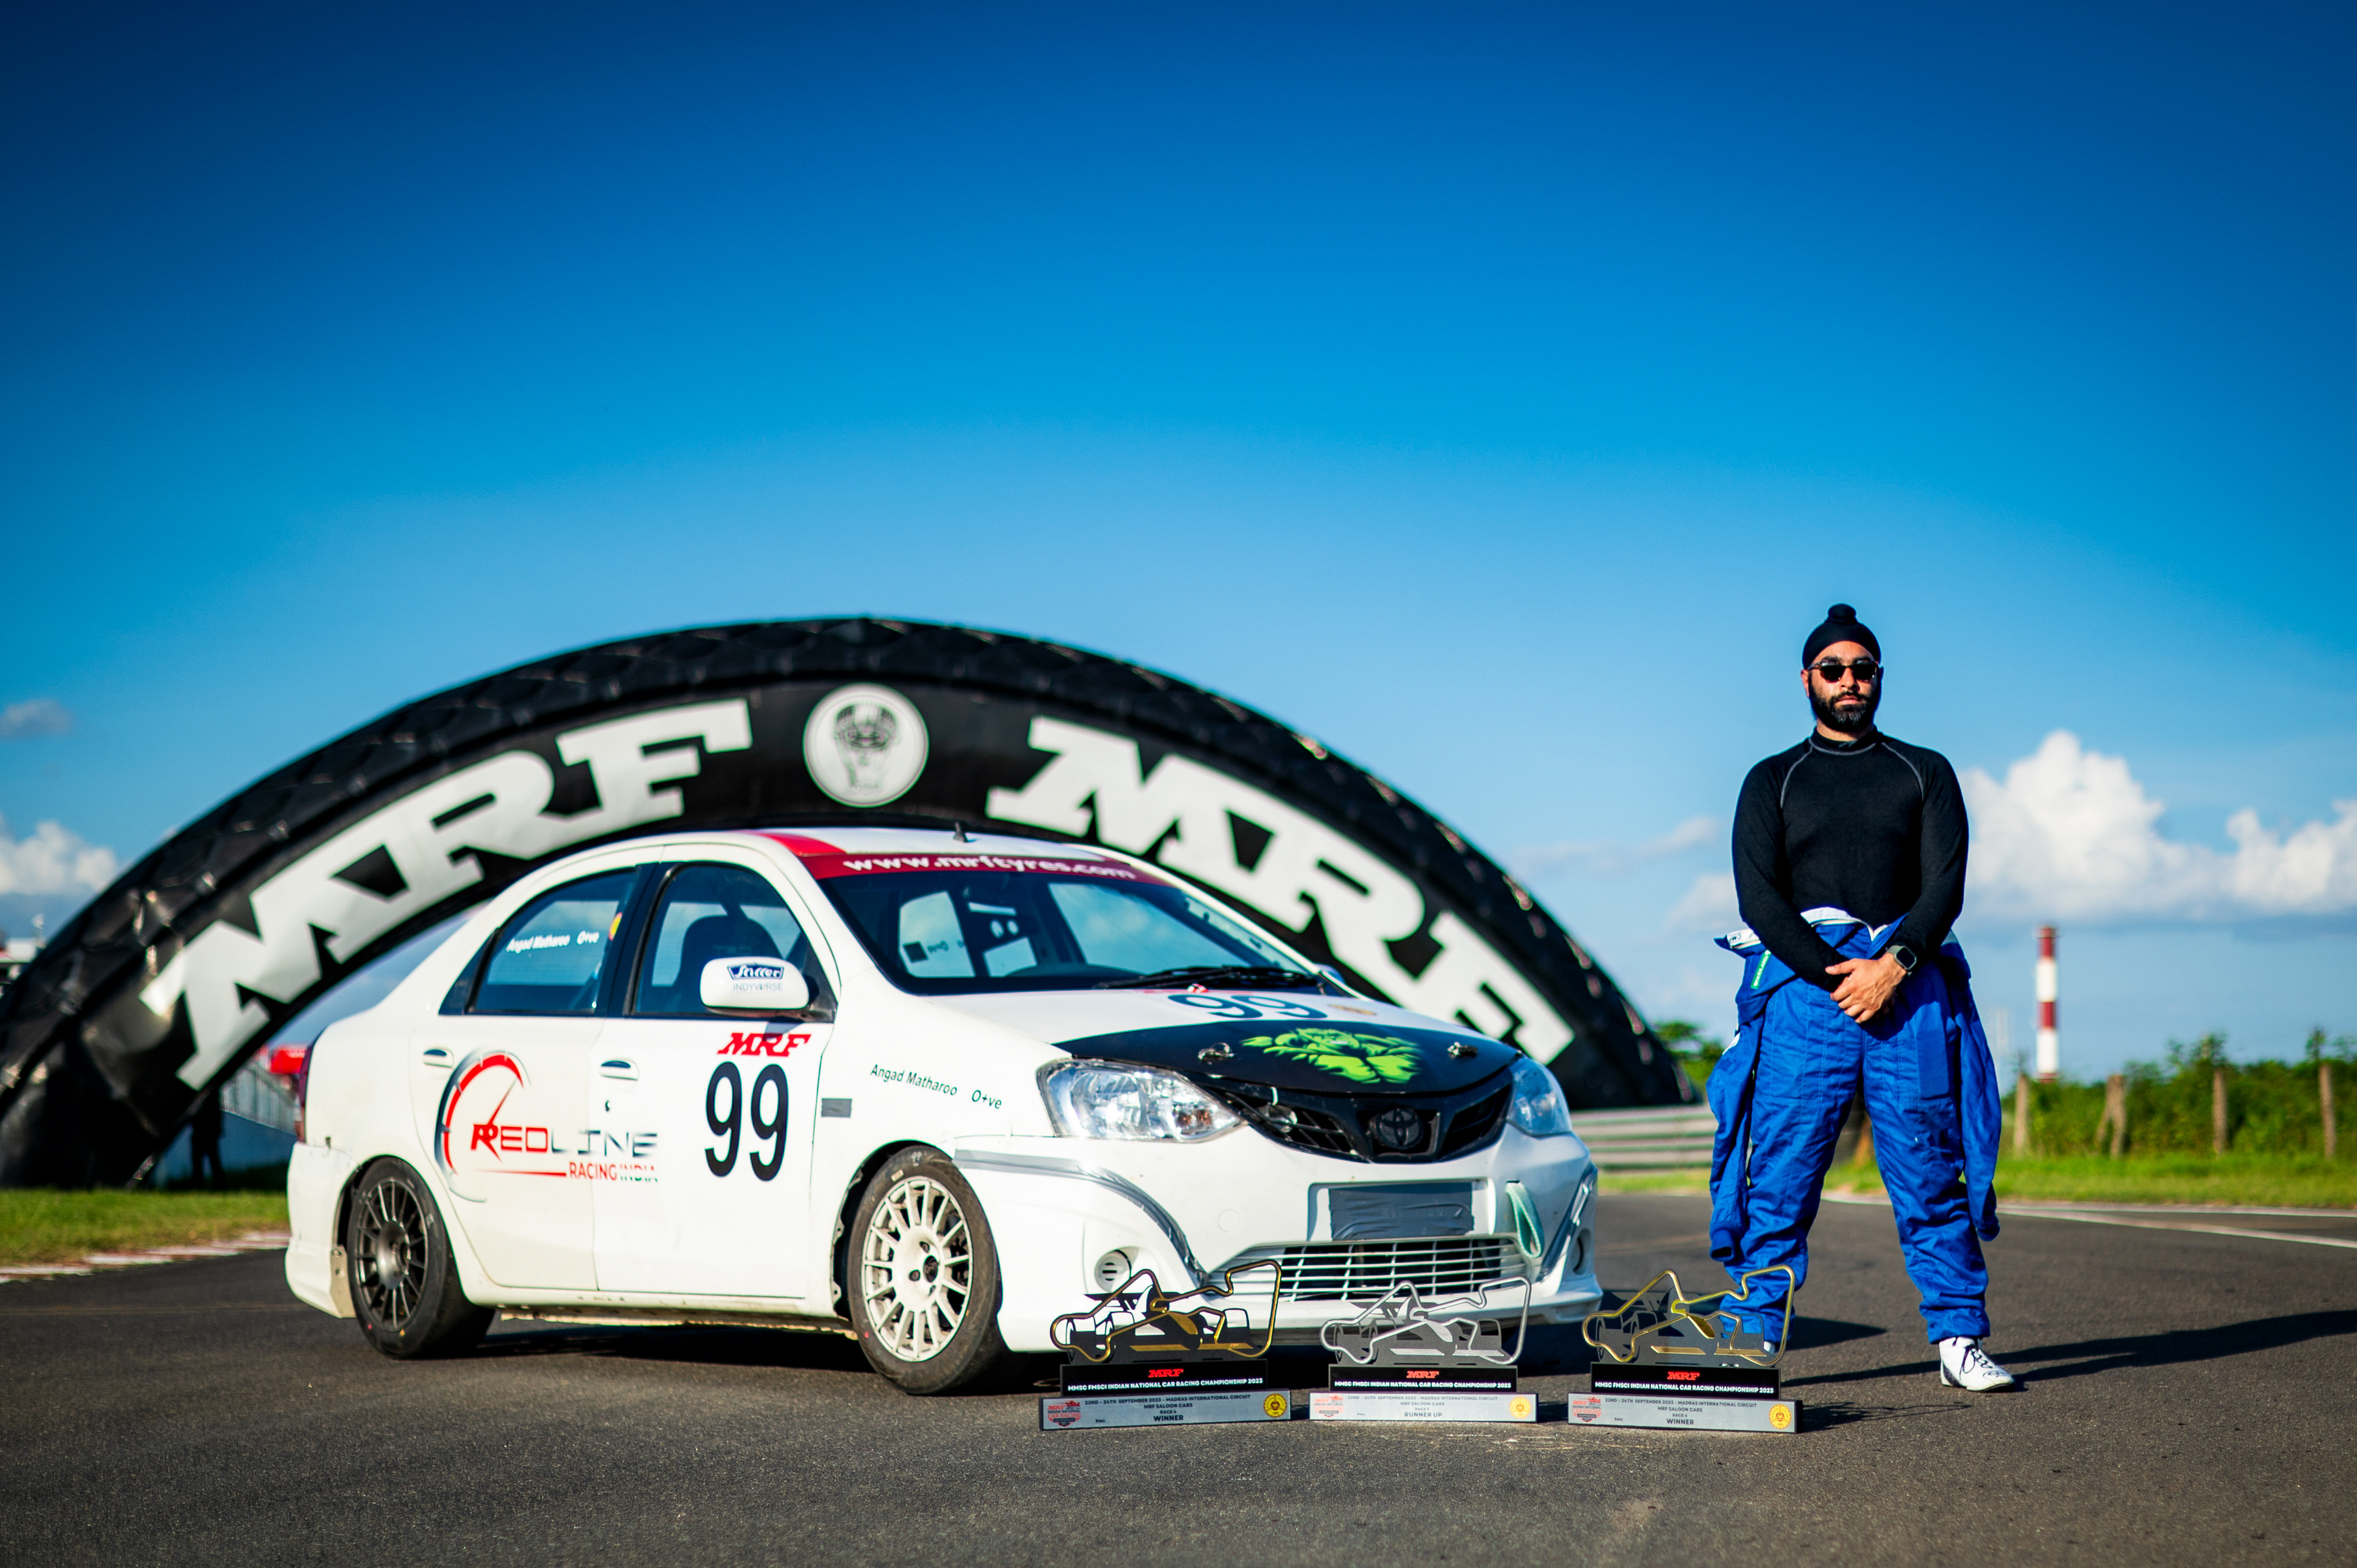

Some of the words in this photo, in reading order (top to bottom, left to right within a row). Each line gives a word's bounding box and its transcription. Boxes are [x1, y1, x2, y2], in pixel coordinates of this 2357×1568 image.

[843, 855, 1136, 879] www.mrftyres.com
[138, 699, 753, 1091] MRF
[987, 716, 1576, 1066] MRF
[1167, 994, 1328, 1019] 99
[717, 1032, 811, 1057] MRF
[870, 1064, 905, 1083] Angad
[906, 1072, 958, 1095] Matharoo
[972, 1089, 1002, 1109] O+ve
[705, 1062, 789, 1181] 99
[470, 1124, 657, 1164] REDLINE
[569, 1162, 617, 1180] RACING
[1148, 1369, 1184, 1378] MRF
[1667, 1371, 1700, 1380] MRF
